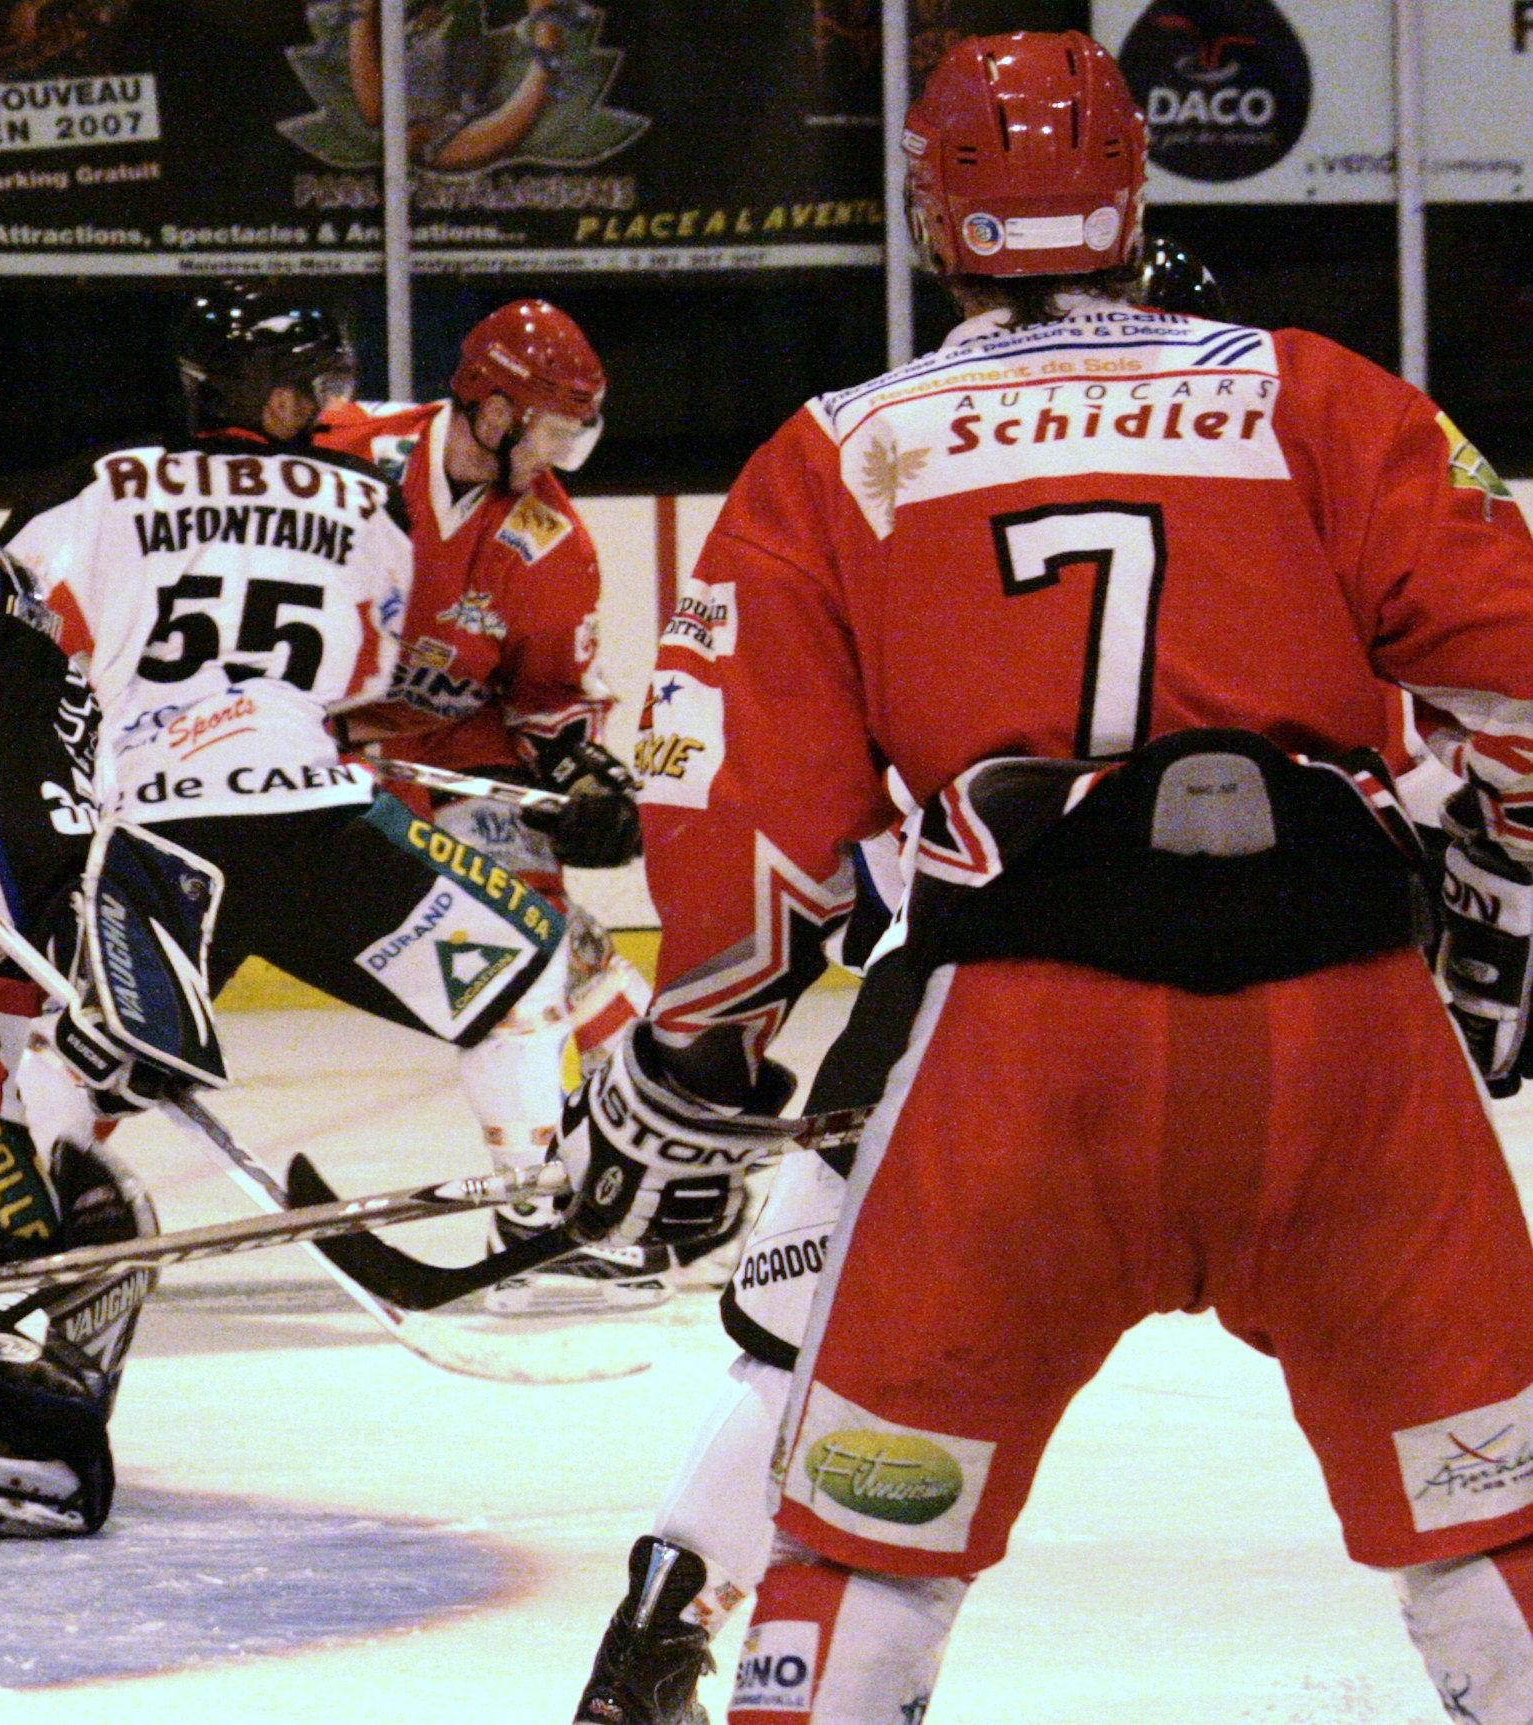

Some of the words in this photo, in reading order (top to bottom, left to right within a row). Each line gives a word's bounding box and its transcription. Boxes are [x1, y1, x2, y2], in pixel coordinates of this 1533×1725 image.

[55, 110, 143, 141] 2007
[1148, 87, 1274, 125] DACO
[75, 160, 161, 187] Gratuit
[160, 223, 309, 249] Spectacles
[317, 222, 339, 243] &
[1121, 324, 1191, 338] Décor
[1049, 360, 1078, 376] de
[1083, 357, 1144, 373] Sols
[955, 378, 1275, 413] AUTOCARS
[948, 403, 1265, 456] Schidler
[105, 453, 379, 520] ACIBOIS
[134, 504, 356, 566] LAFONTAINE
[136, 574, 324, 692] 55
[989, 499, 1168, 758] 7
[167, 696, 258, 749] Sports
[136, 771, 204, 805] de
[226, 765, 358, 796] CAEN
[406, 818, 548, 912] COLLET
[367, 891, 454, 972] DURAND
[66, 1267, 152, 1344] VAUGHN
